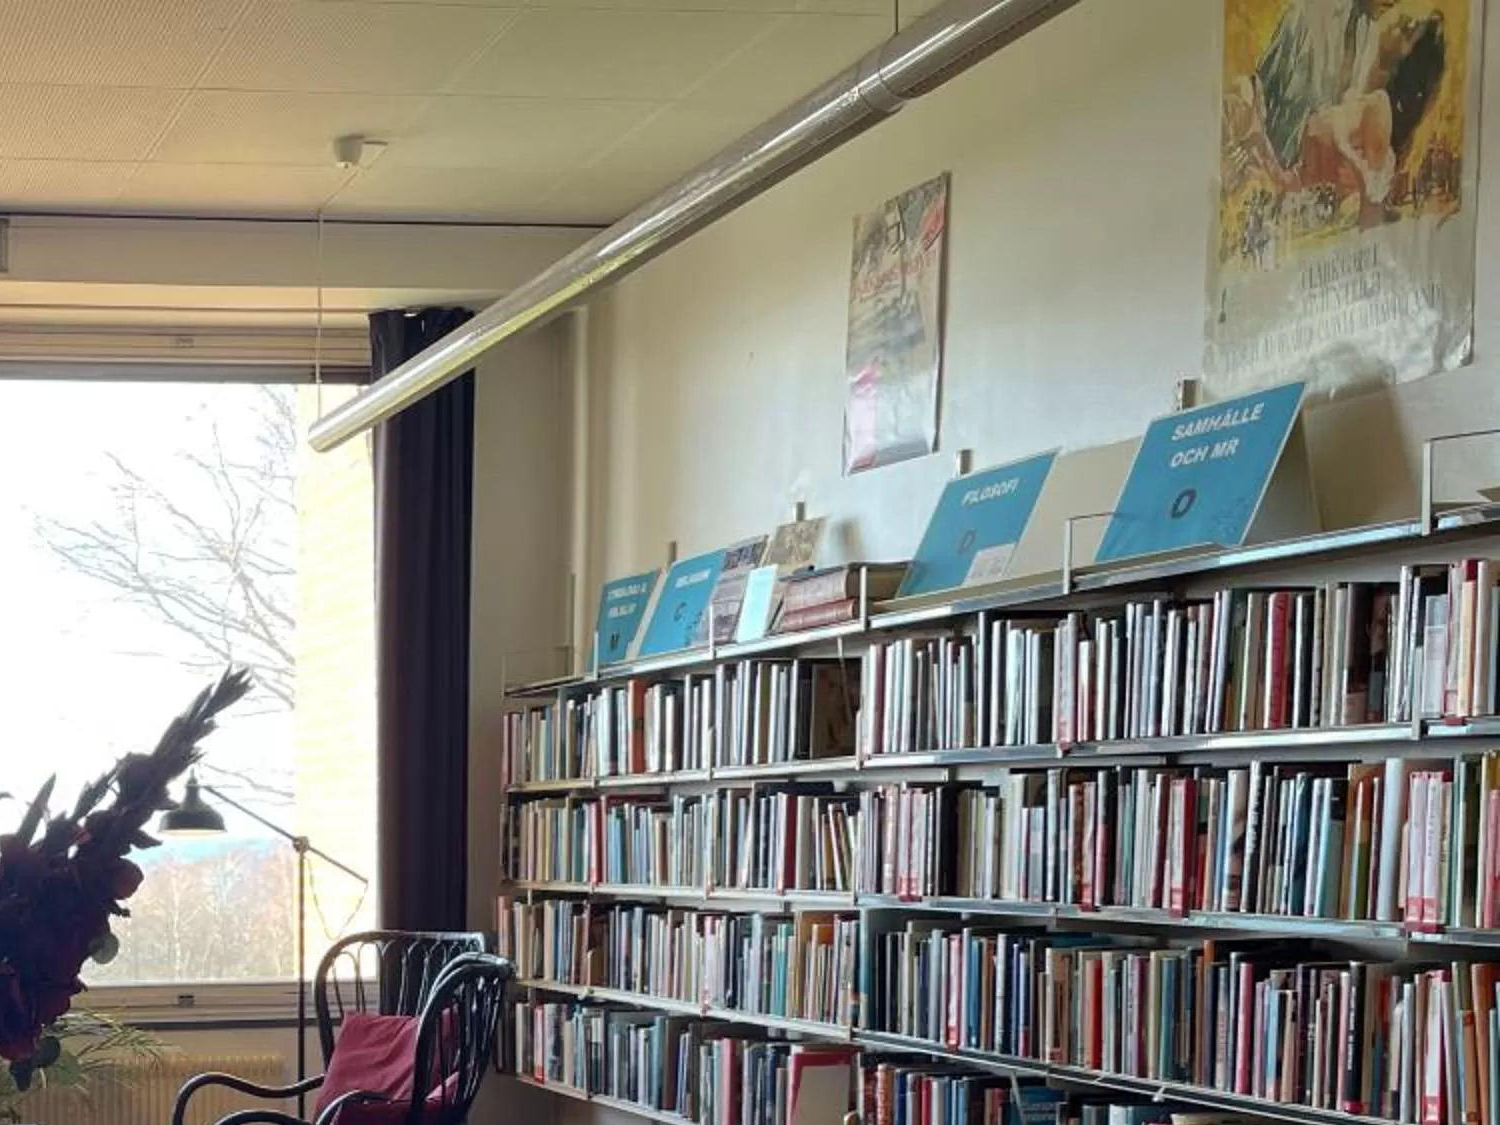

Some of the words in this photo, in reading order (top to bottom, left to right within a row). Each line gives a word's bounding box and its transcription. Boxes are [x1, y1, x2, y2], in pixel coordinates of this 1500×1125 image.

[1171, 402, 1265, 441] SAMHÄLLE
[1170, 444, 1210, 469] OCH
[1210, 437, 1240, 459] MR
[961, 477, 1021, 507] FILOSOFI
